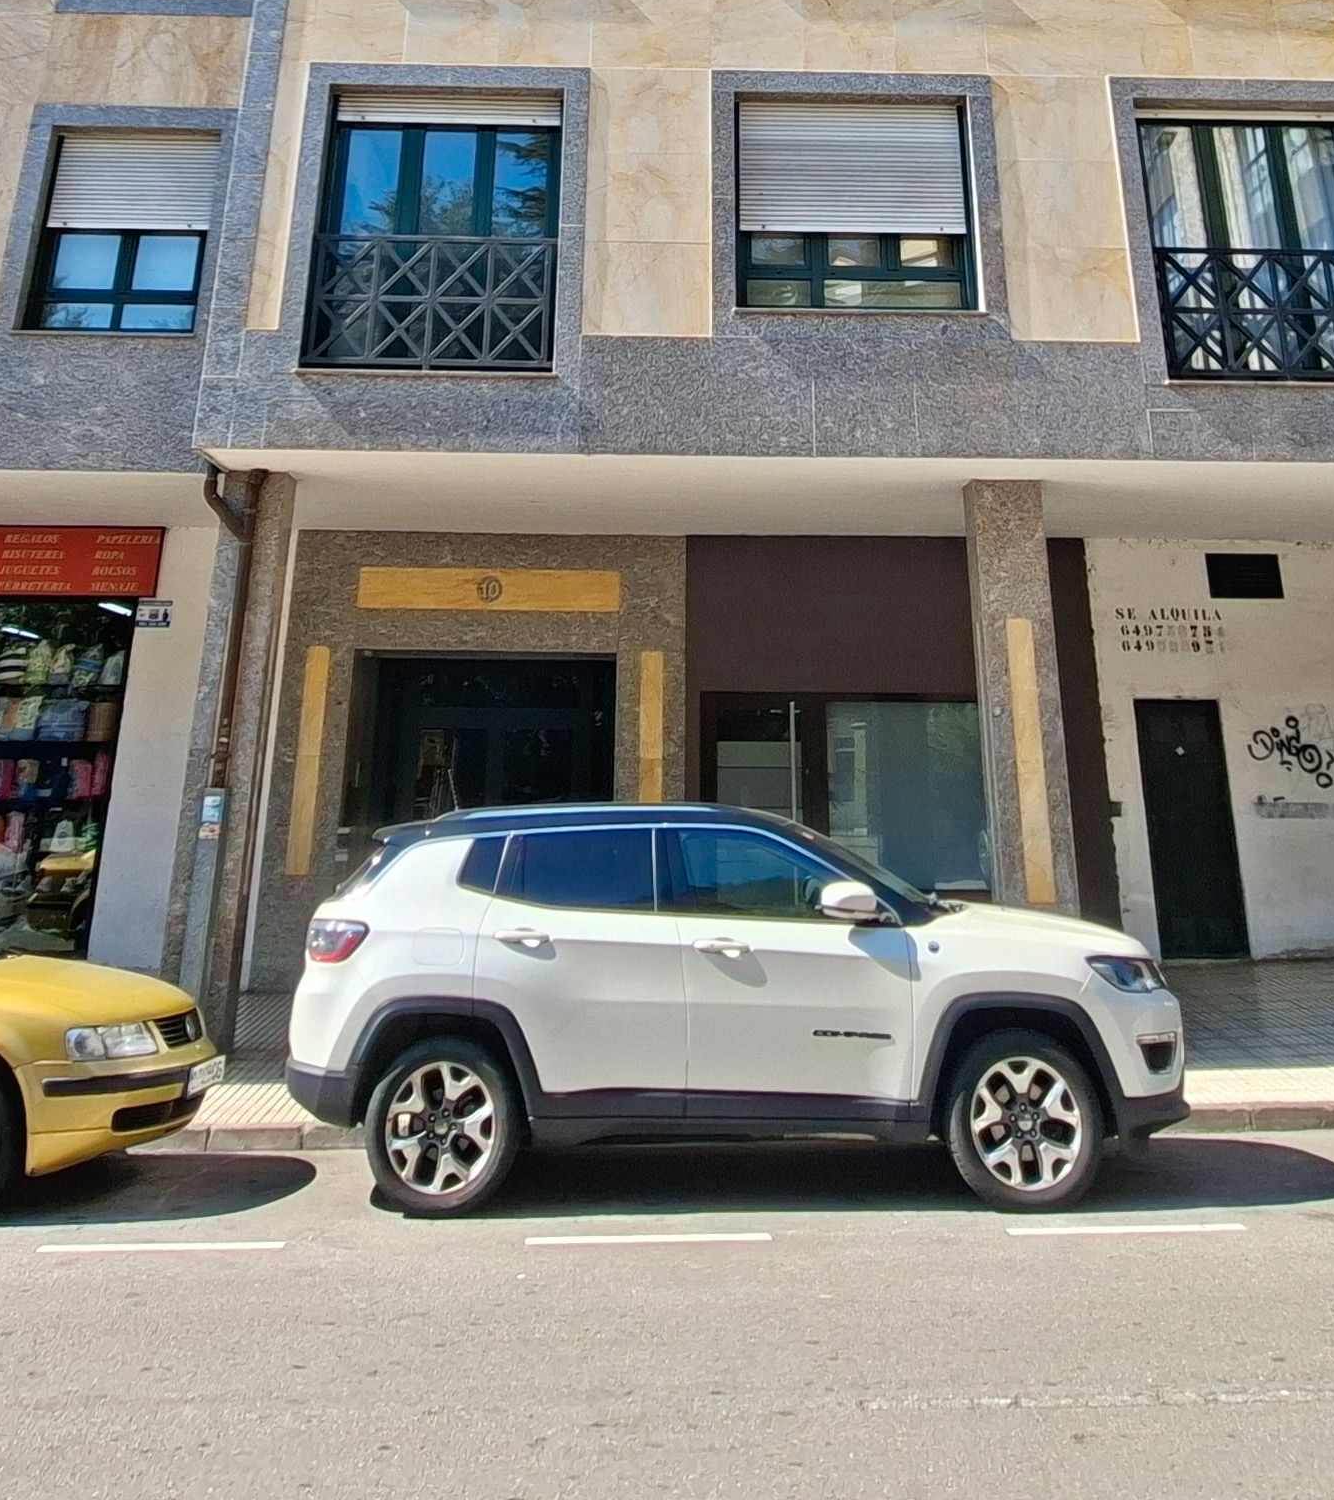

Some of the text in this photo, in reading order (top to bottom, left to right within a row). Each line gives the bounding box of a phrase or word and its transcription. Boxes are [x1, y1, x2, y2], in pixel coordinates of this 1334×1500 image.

[4, 534, 61, 544] REGALOS
[94, 550, 125, 560] ROPA
[91, 566, 137, 576] BOLSOS
[90, 582, 139, 592] MENAJE
[479, 580, 499, 599] 10
[1115, 607, 1222, 621] SE ALQUILA
